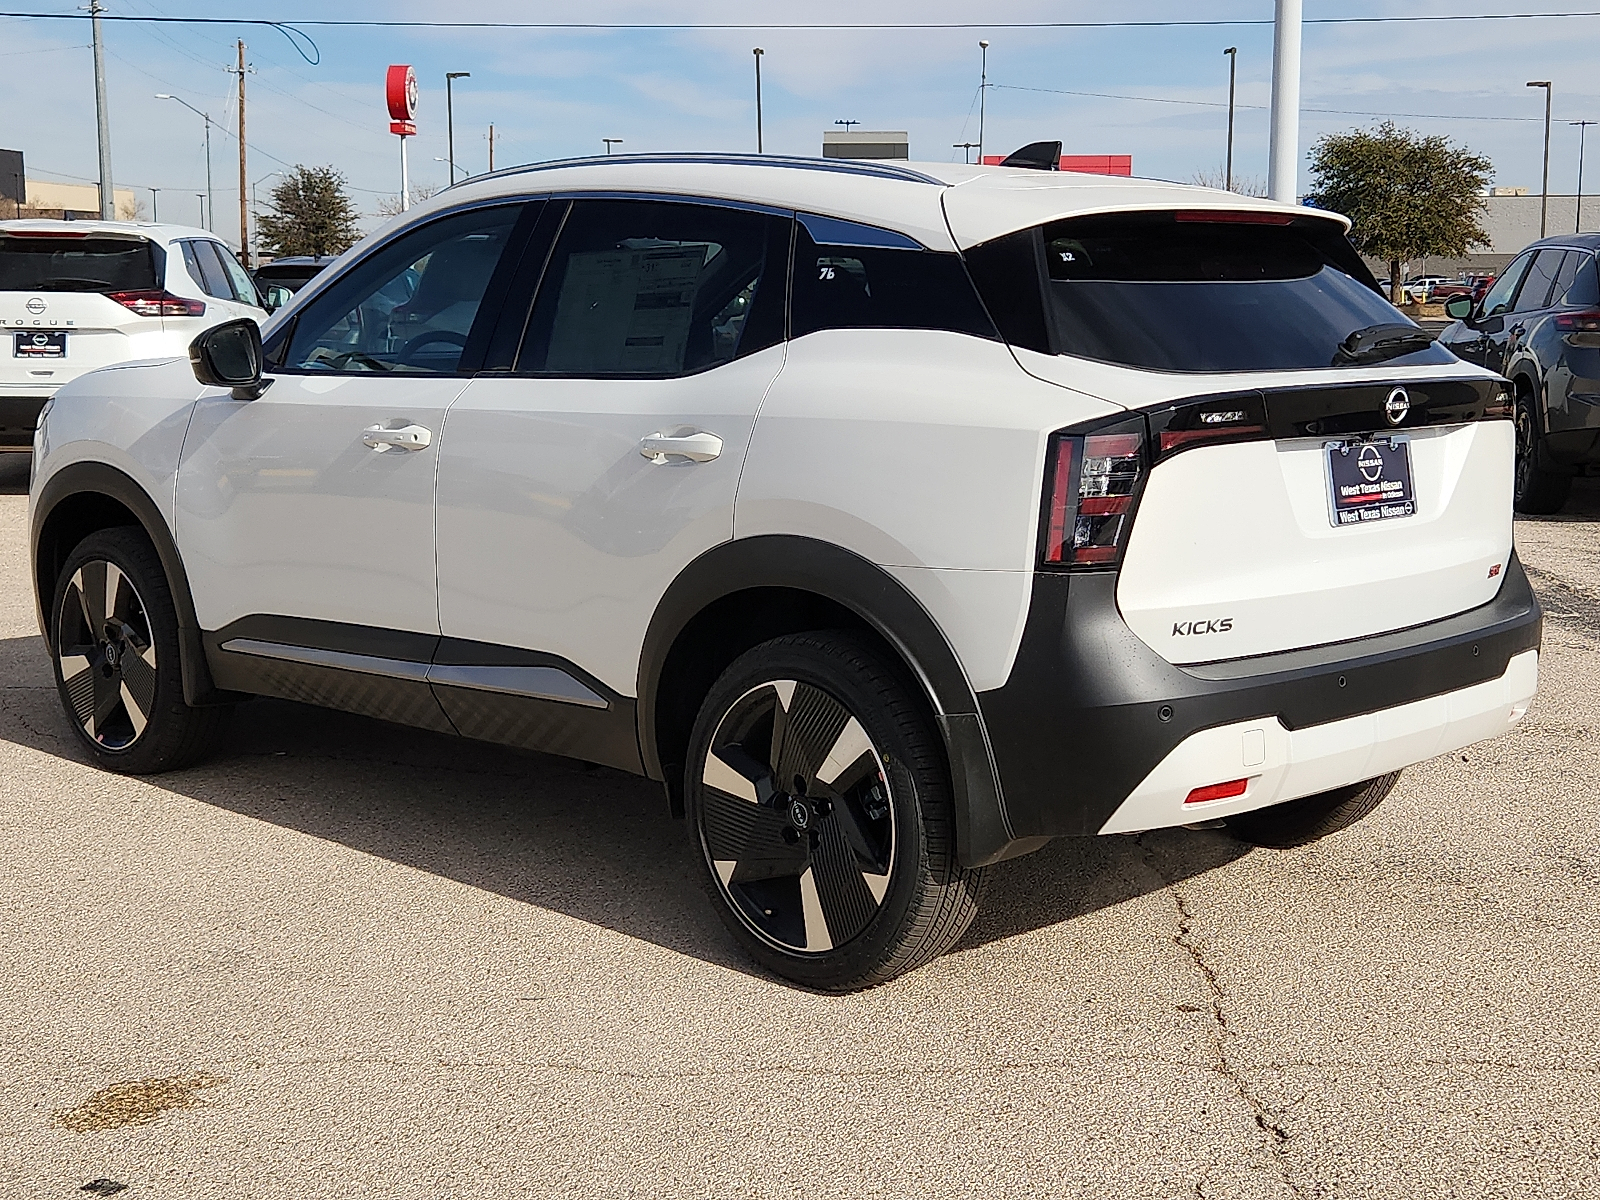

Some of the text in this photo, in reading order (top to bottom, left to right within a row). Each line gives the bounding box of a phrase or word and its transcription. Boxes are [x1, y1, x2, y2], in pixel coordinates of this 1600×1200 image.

[1358, 459, 1383, 468] NISSAN
[1341, 481, 1403, 496] West Texas Nissan
[1340, 504, 1405, 523] West Texas Nissan
[1171, 617, 1234, 637] KICKS
